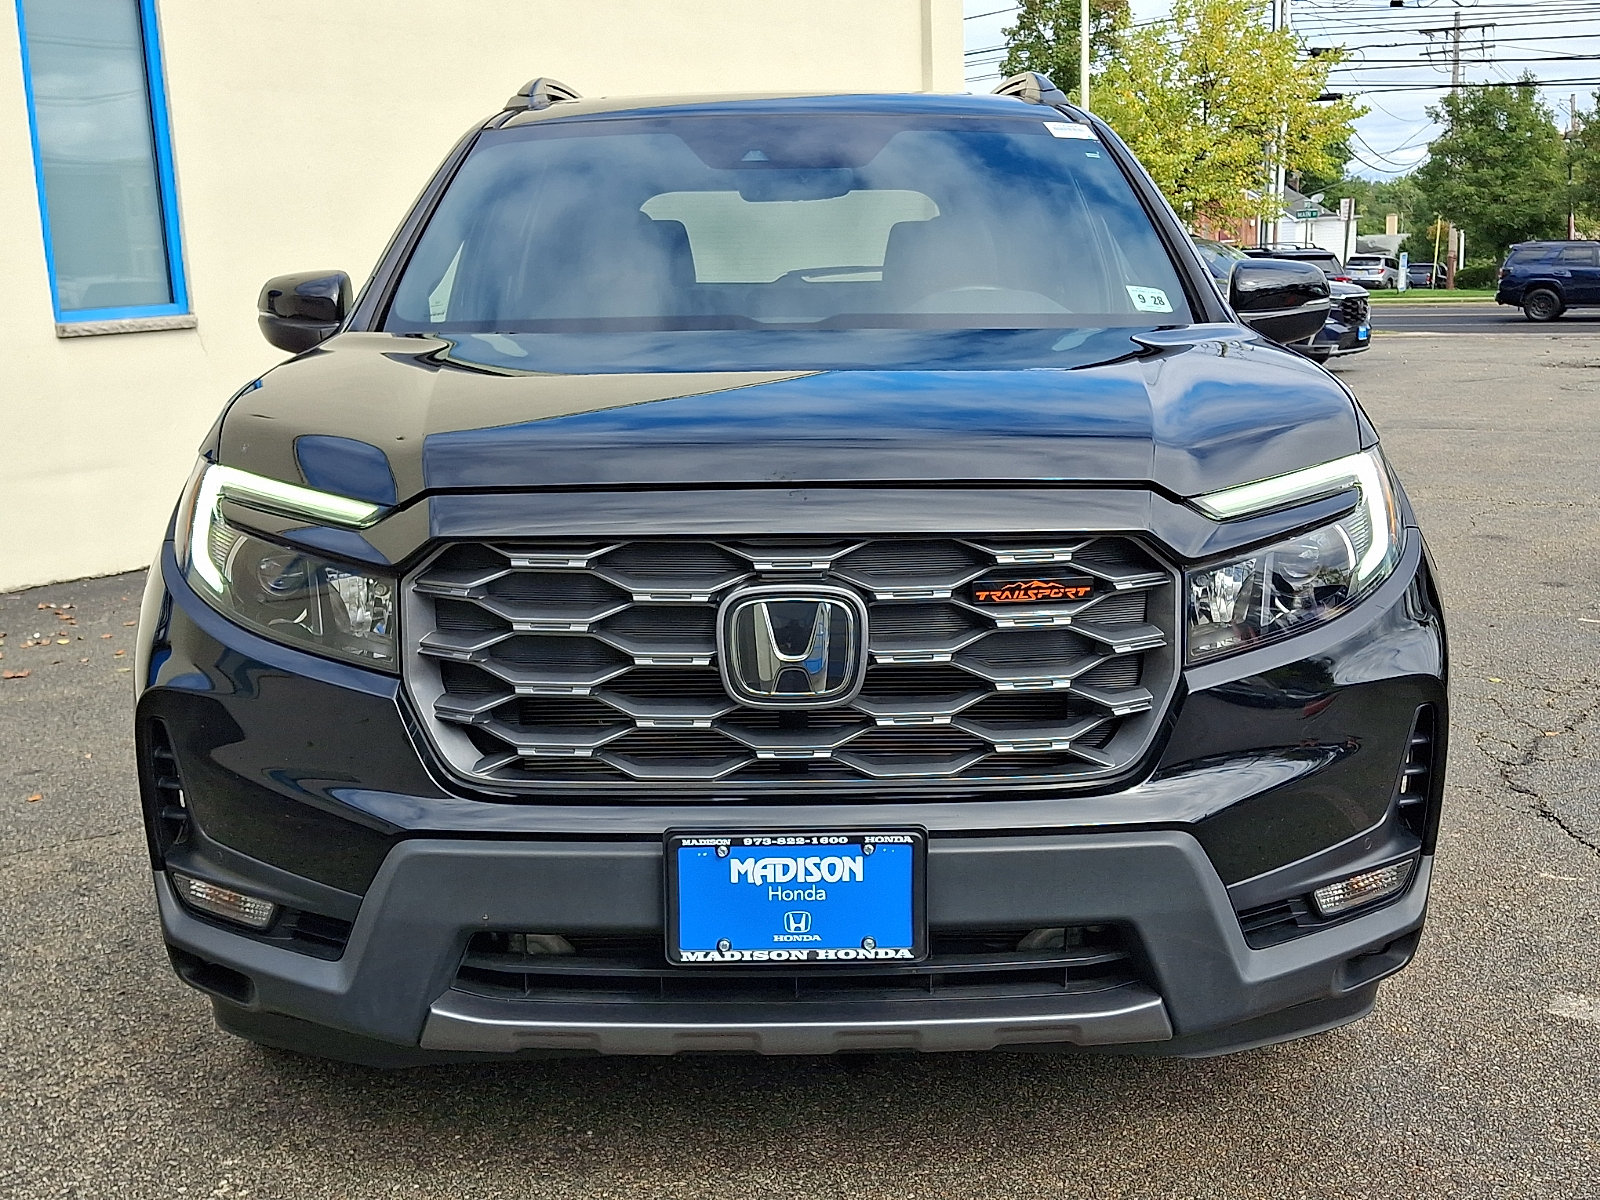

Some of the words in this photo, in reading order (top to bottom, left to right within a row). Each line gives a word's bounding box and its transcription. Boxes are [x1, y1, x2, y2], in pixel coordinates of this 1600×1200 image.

[1138, 294, 1146, 303] 9
[1151, 295, 1165, 305] 28
[975, 587, 1090, 602] TRAILSPORT
[743, 836, 849, 846] 973-822-1600
[864, 836, 914, 844] HONDA
[730, 856, 864, 886] MADISON
[768, 885, 827, 901] Honda
[772, 934, 822, 942] HONDA
[680, 950, 809, 962] MADISON
[816, 949, 915, 960] HONDA
